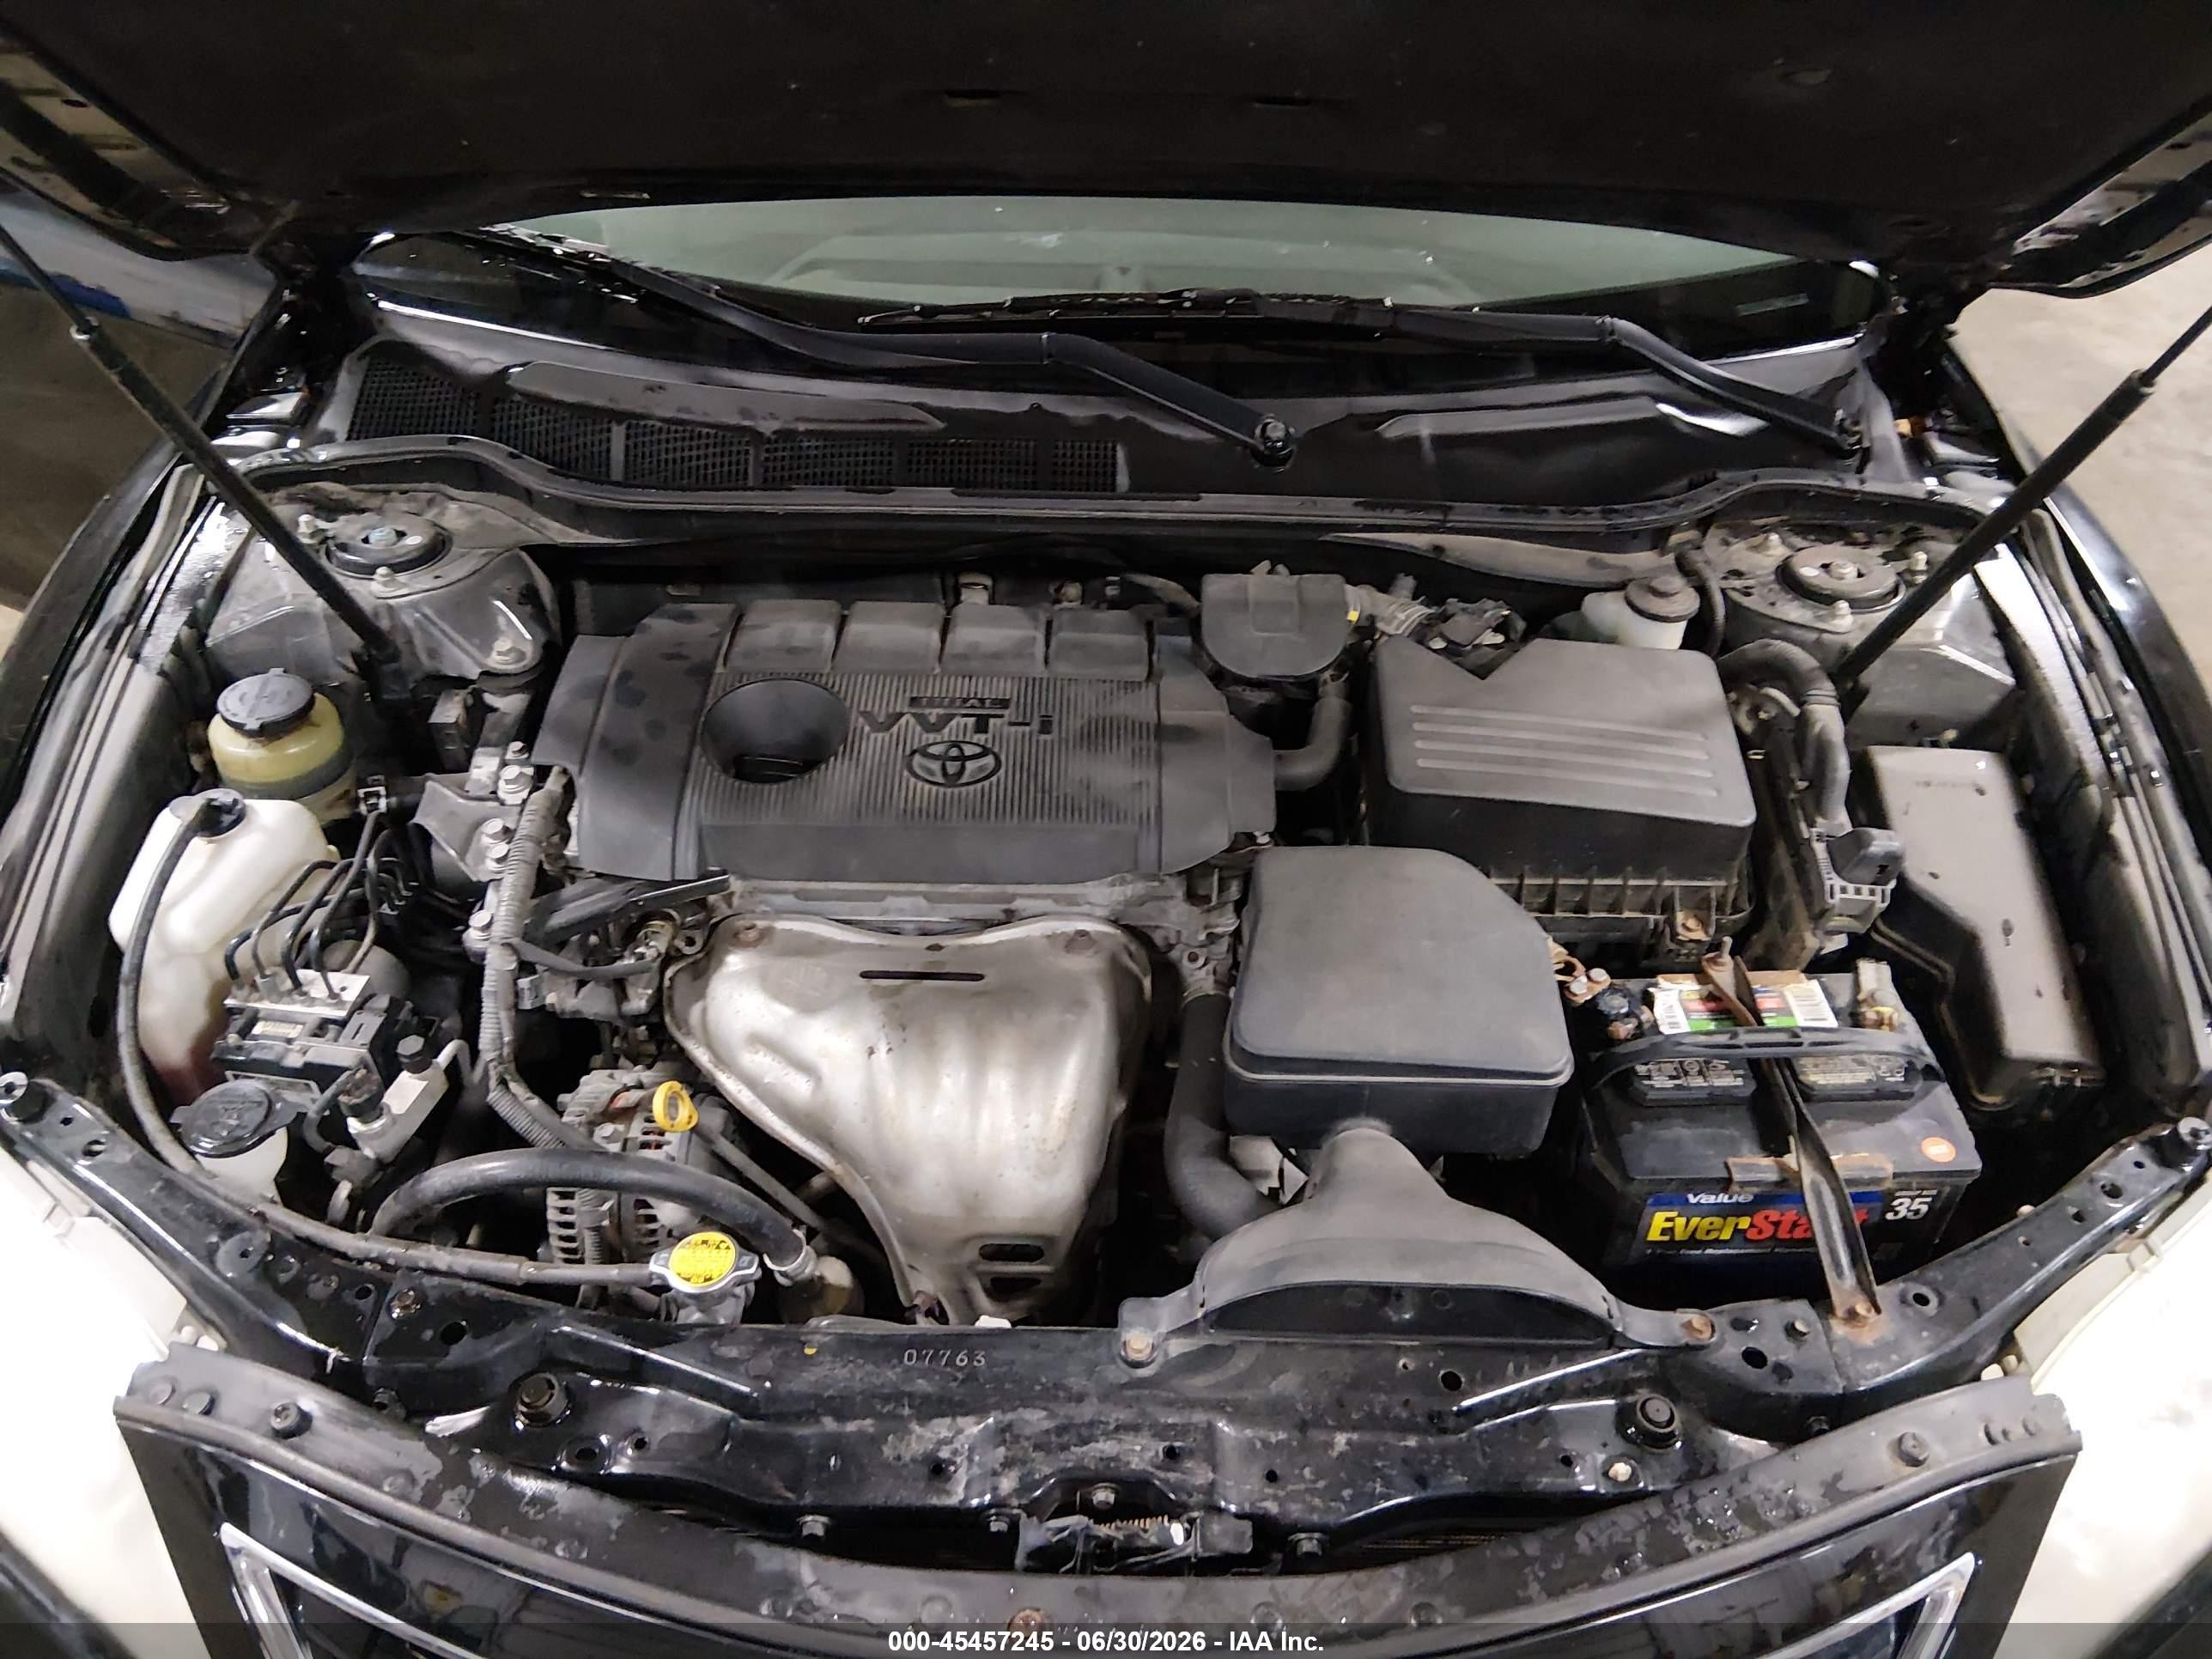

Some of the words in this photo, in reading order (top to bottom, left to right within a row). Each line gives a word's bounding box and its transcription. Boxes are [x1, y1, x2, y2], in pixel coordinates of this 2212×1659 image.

[860, 712, 1054, 734] VVT-i
[1686, 1192, 1754, 1204] Value
[1885, 1197, 1933, 1220] 35
[1646, 1209, 1869, 1242] EverSta
[903, 1348, 986, 1367] 07763
